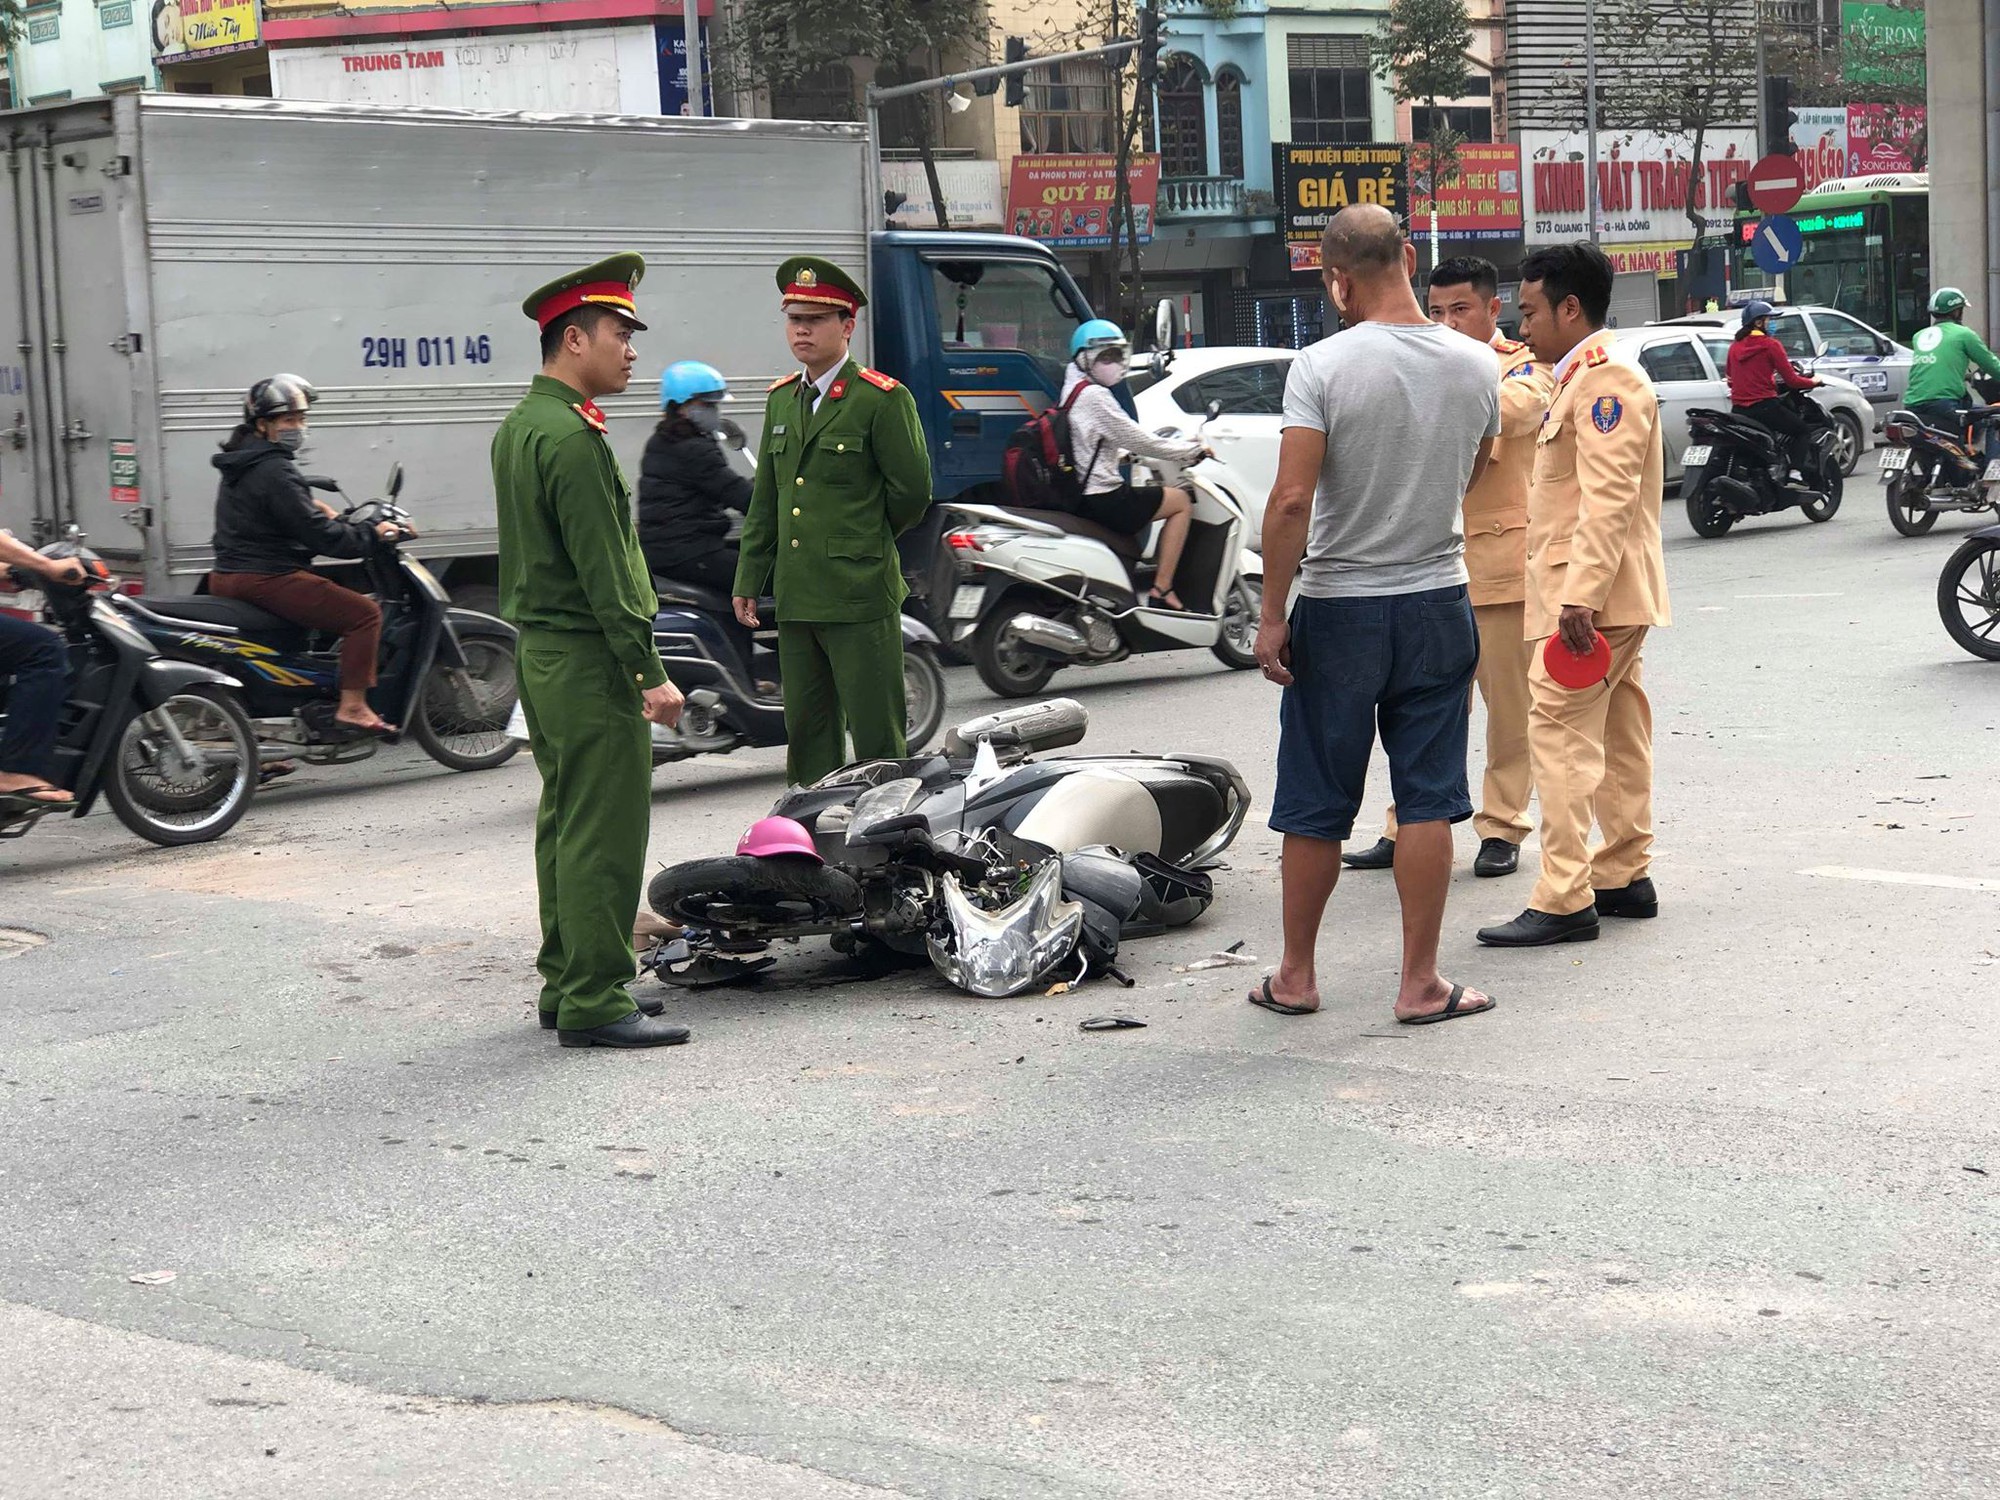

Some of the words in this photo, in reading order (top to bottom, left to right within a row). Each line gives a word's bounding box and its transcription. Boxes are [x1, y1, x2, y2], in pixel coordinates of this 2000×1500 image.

[342, 52, 402, 72] TRUNG
[405, 51, 444, 69] TAM
[1314, 146, 1341, 165] KIỆN
[1298, 171, 1349, 207] GIÁ
[1466, 168, 1486, 190] THIẾT
[1487, 167, 1497, 190] KẾ
[1534, 150, 1585, 213] KÍNH
[1042, 182, 1089, 205] QUÝ
[1478, 196, 1495, 216] KÍNH
[1502, 199, 1519, 216] INOX
[1535, 220, 1552, 233] 573
[1554, 223, 1583, 233] QUANG
[1615, 219, 1626, 231] HÀ
[1628, 219, 1650, 231] ĐÔNG
[362, 337, 406, 368] 29H
[417, 336, 455, 367] 011
[463, 334, 490, 364] 46
